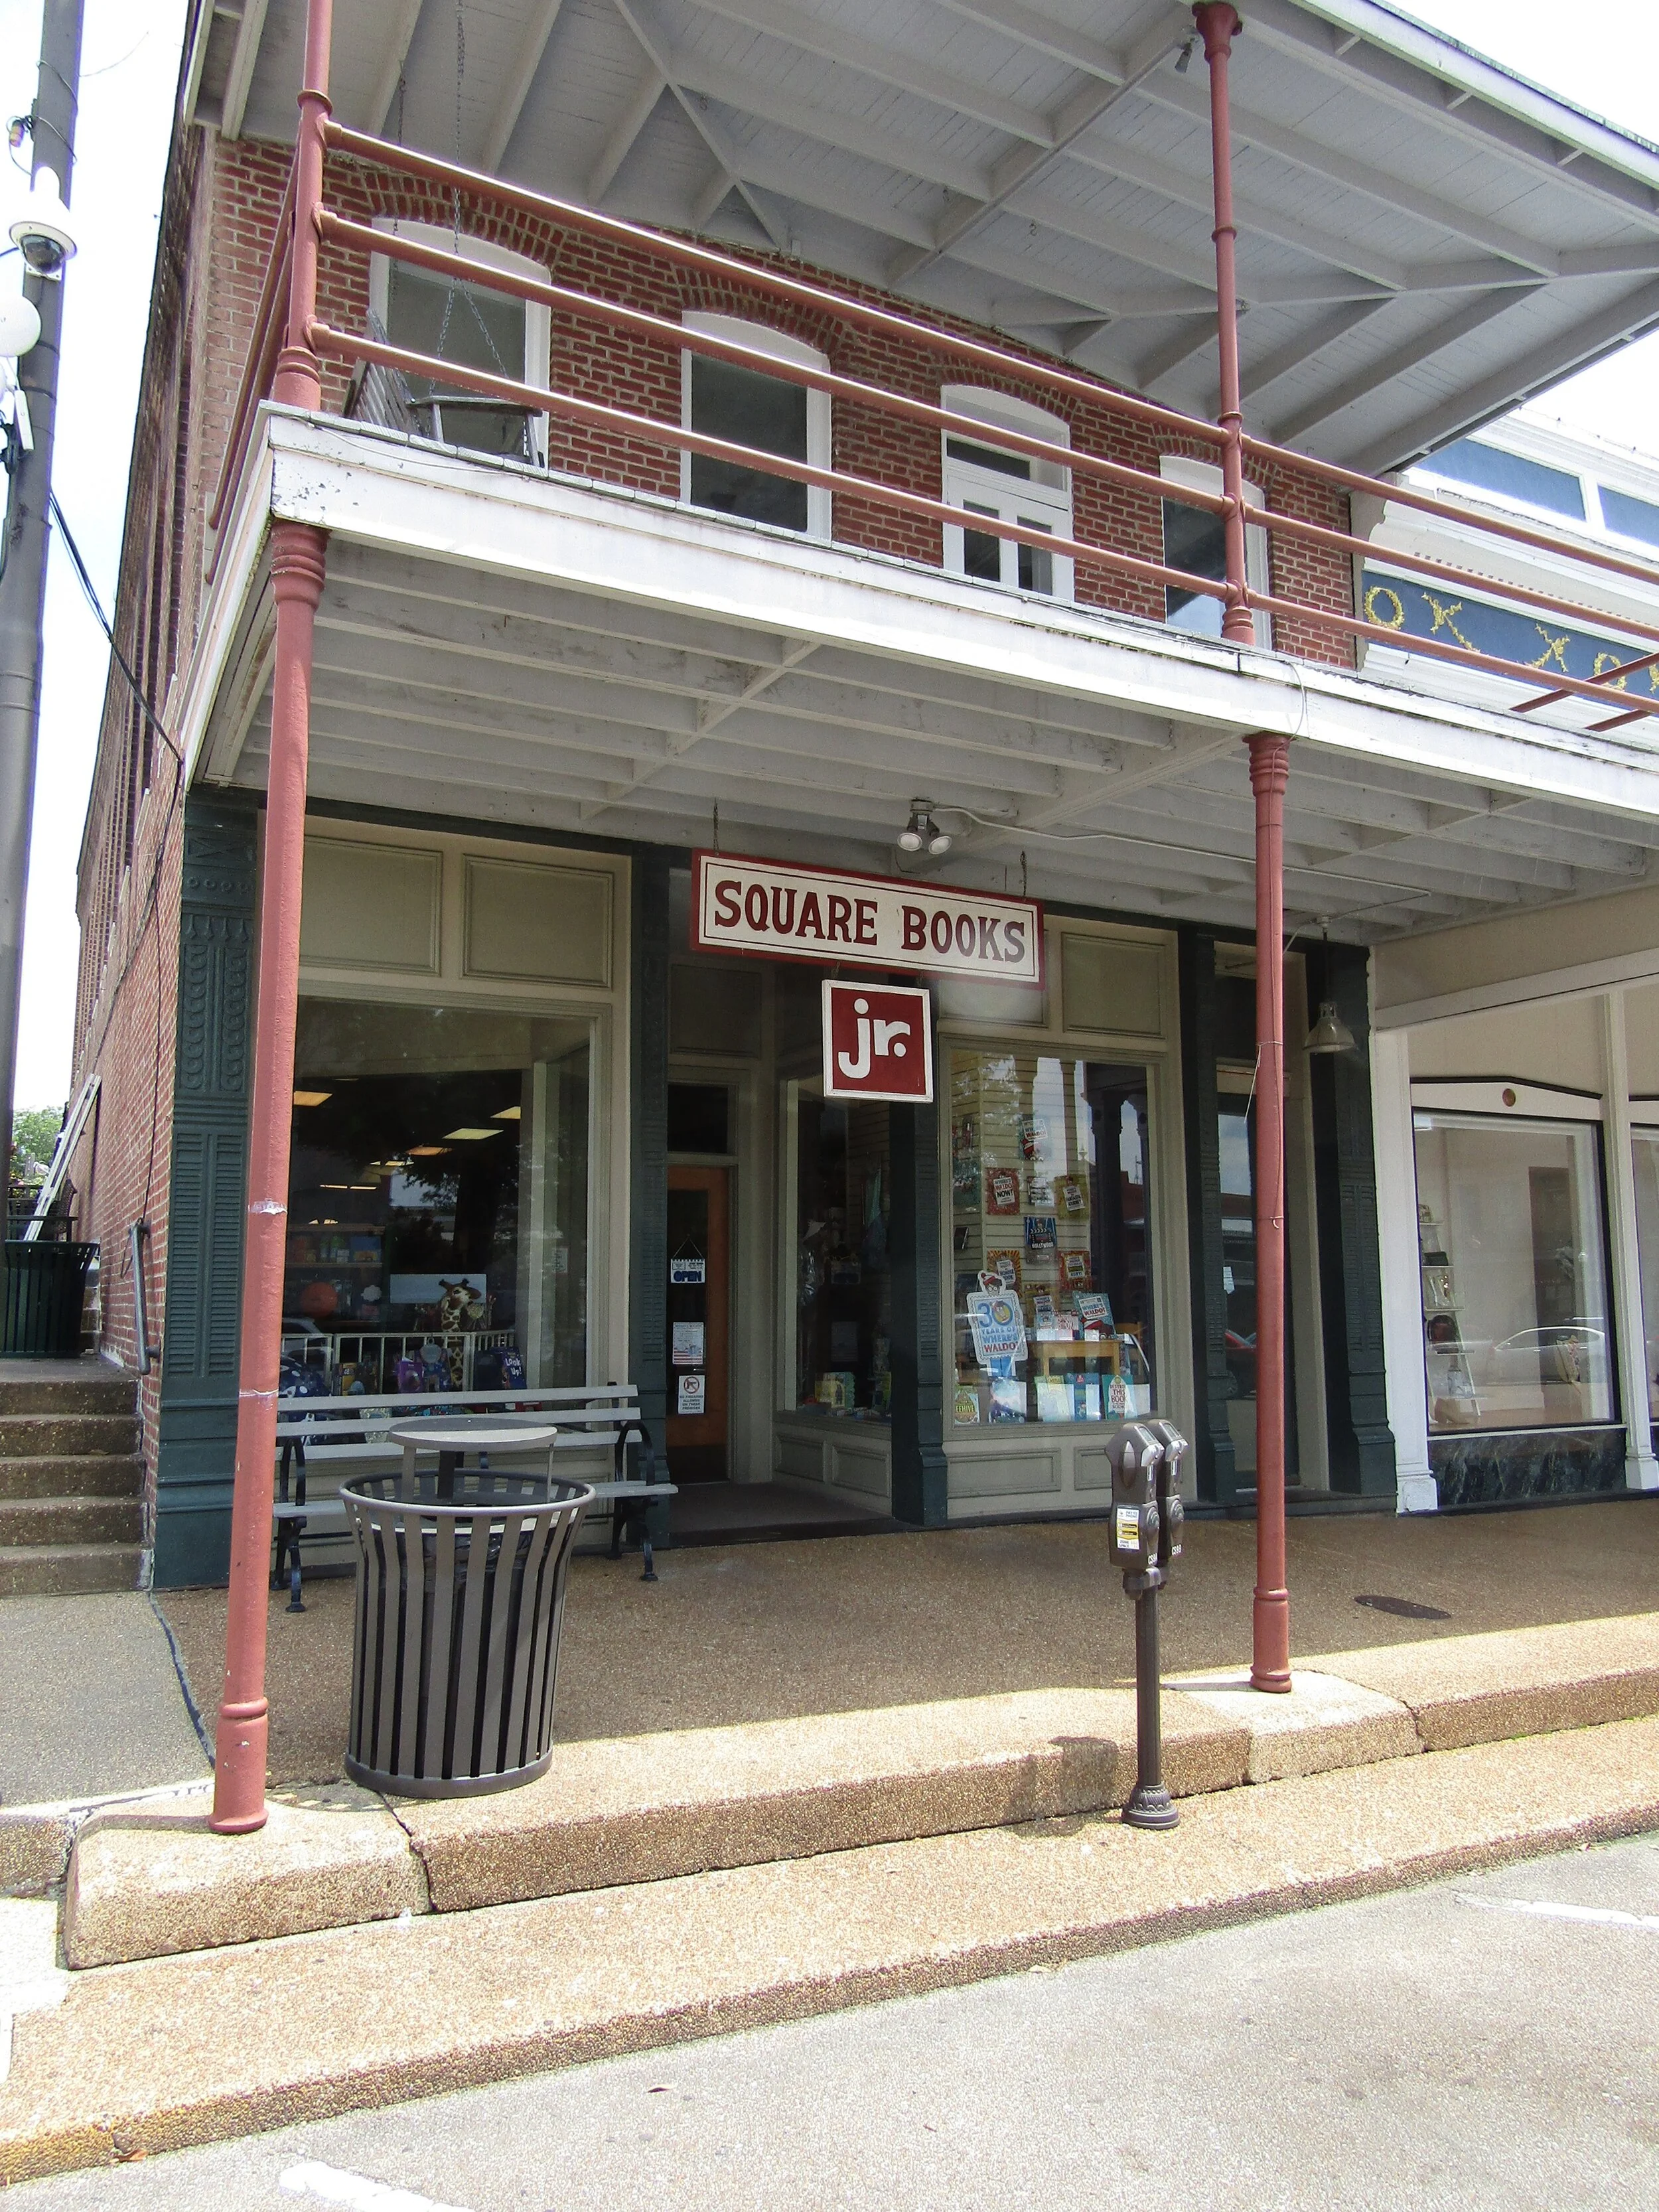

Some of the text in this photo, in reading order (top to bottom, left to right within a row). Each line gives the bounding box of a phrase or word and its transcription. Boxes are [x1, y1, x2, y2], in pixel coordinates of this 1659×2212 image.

[714, 880, 1025, 964] SQUARE BOOKS
[837, 997, 911, 1079] jr.
[997, 1189, 1014, 1198] NOW?
[674, 1270, 702, 1282] OPEN
[977, 1301, 1013, 1328] 30
[510, 1366, 522, 1376] Up!
